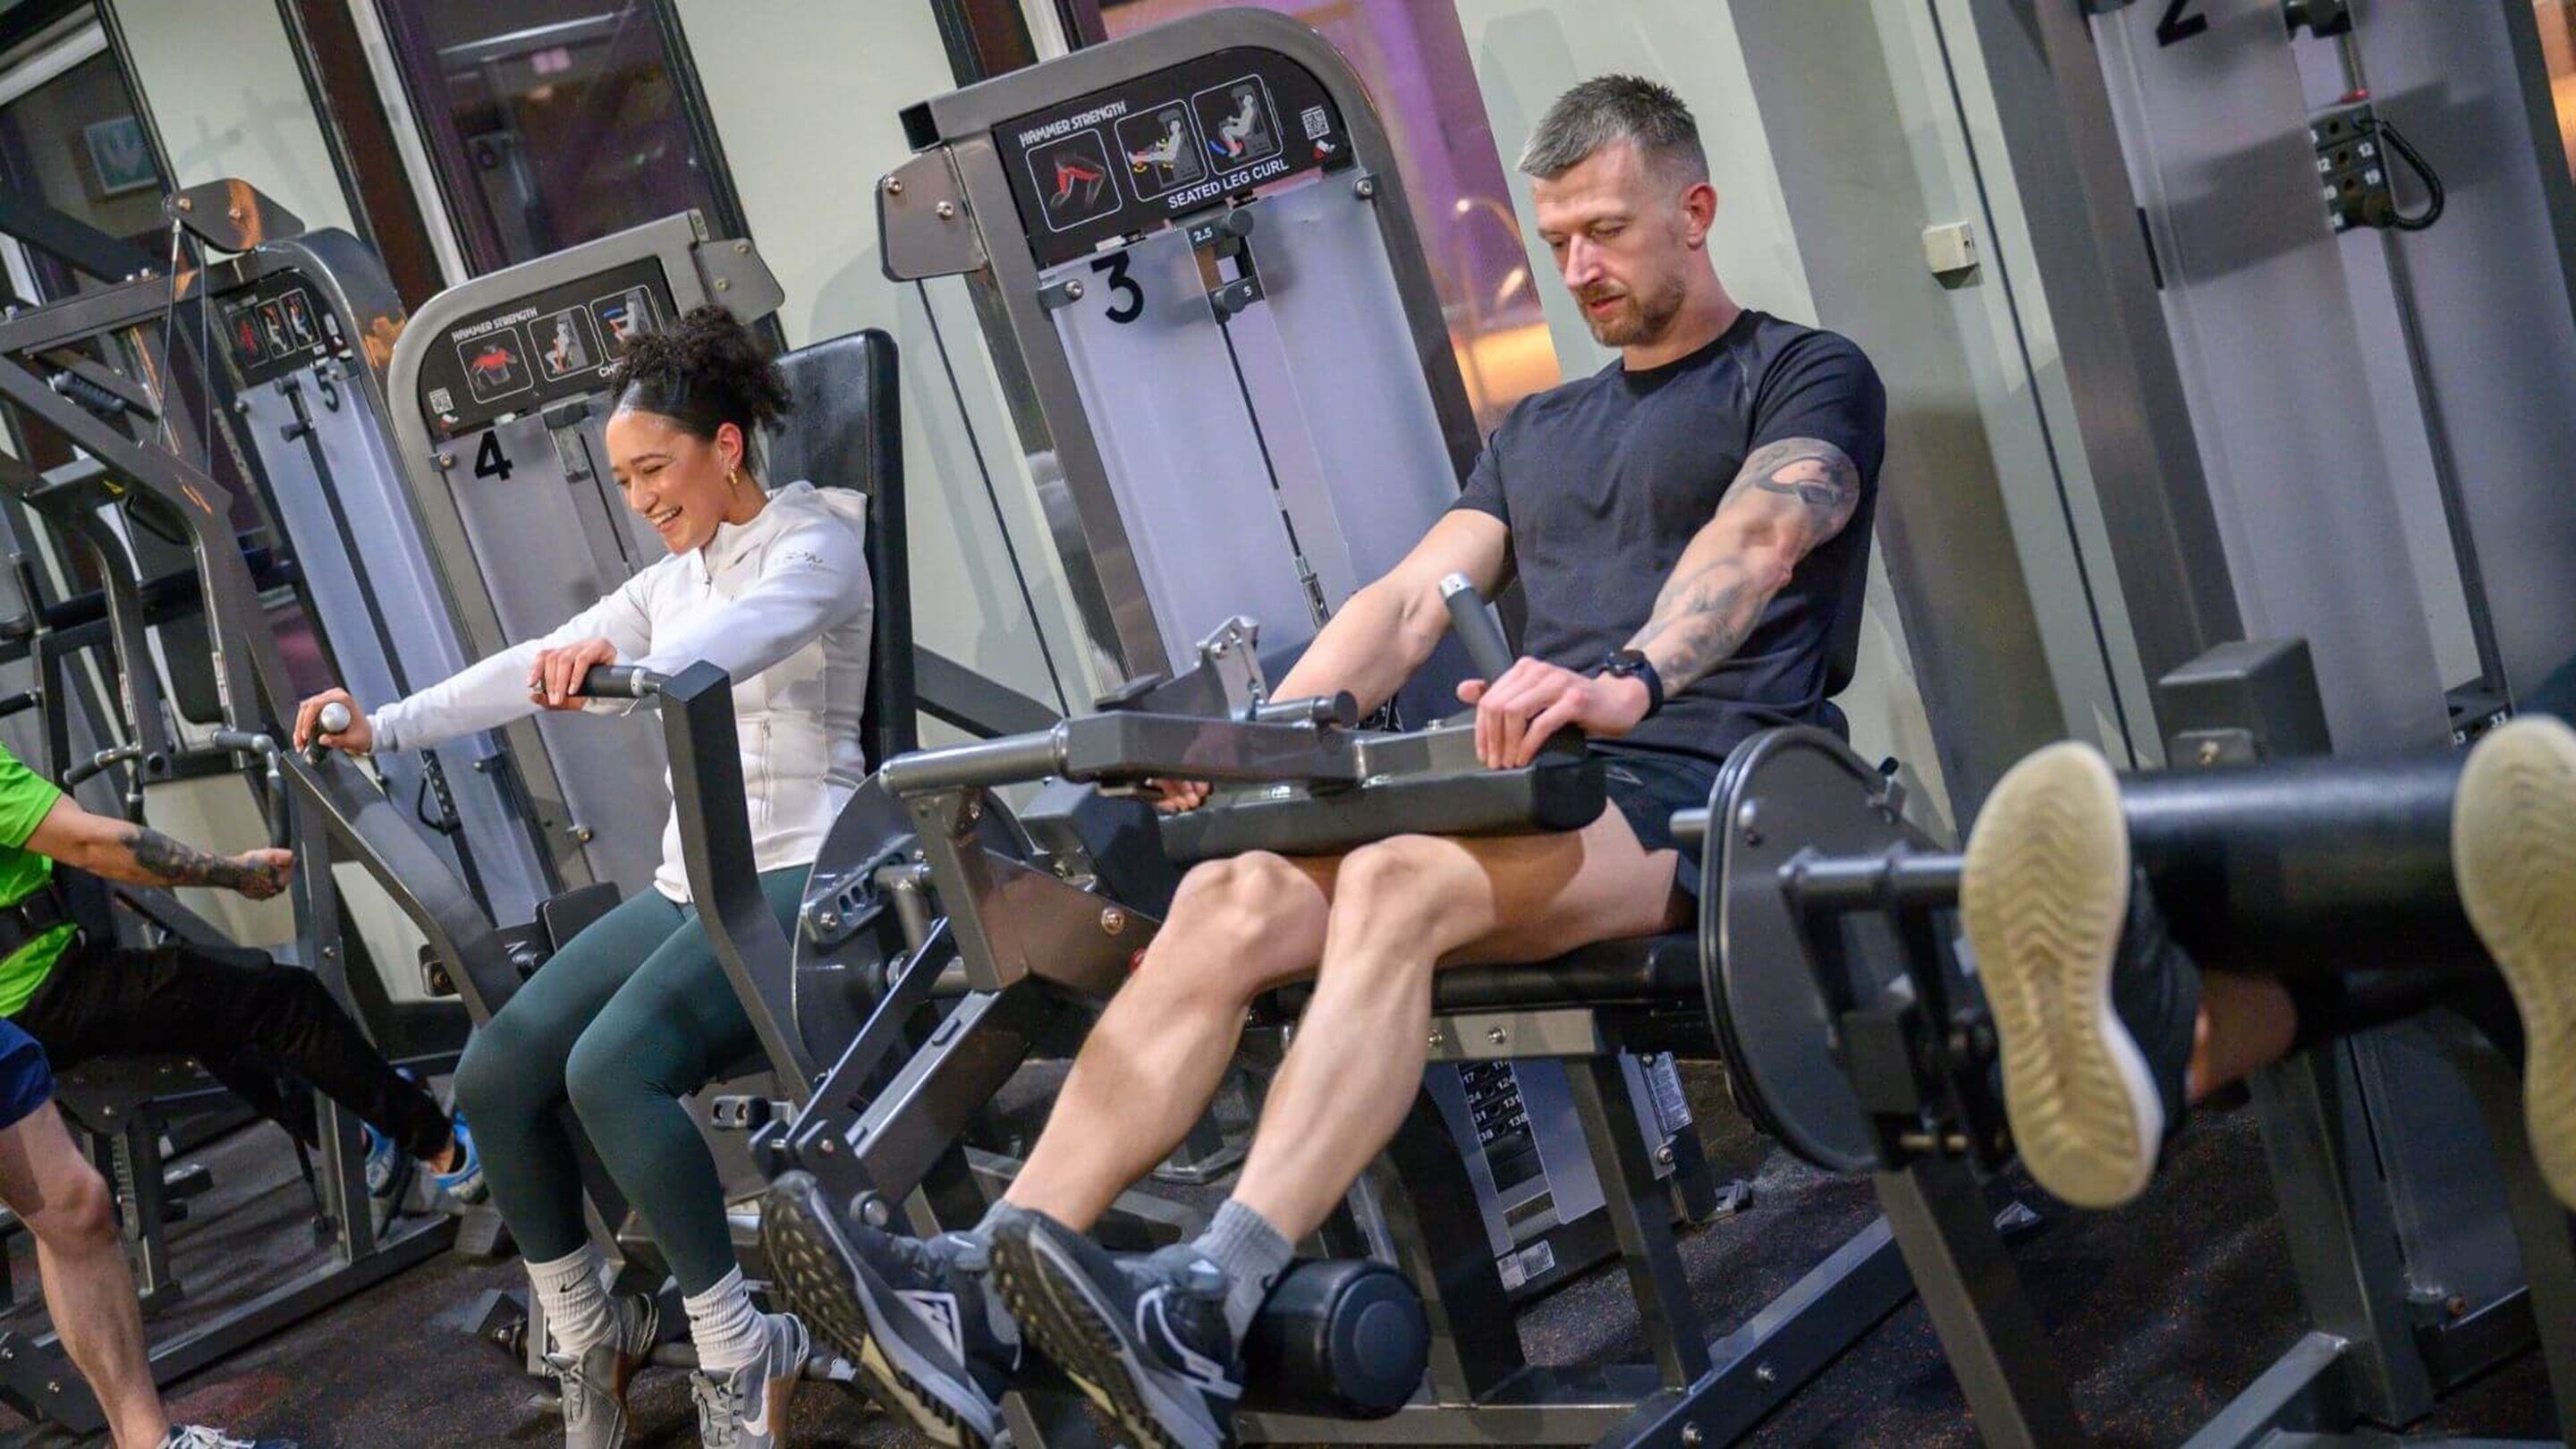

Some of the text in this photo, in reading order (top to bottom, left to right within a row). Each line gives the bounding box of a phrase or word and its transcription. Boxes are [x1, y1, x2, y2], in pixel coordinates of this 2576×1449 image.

[1019, 99, 1128, 148] HAMMER STRENGTH
[2358, 141, 2375, 157] 12
[1167, 158, 1290, 208] SEATED LEG CURL
[1192, 226, 1213, 242] 2.5
[1089, 250, 1145, 325] 3
[1243, 285, 1252, 297] 5
[314, 367, 340, 413] 5
[474, 429, 513, 481] 4
[1504, 1094, 1521, 1108] 131
